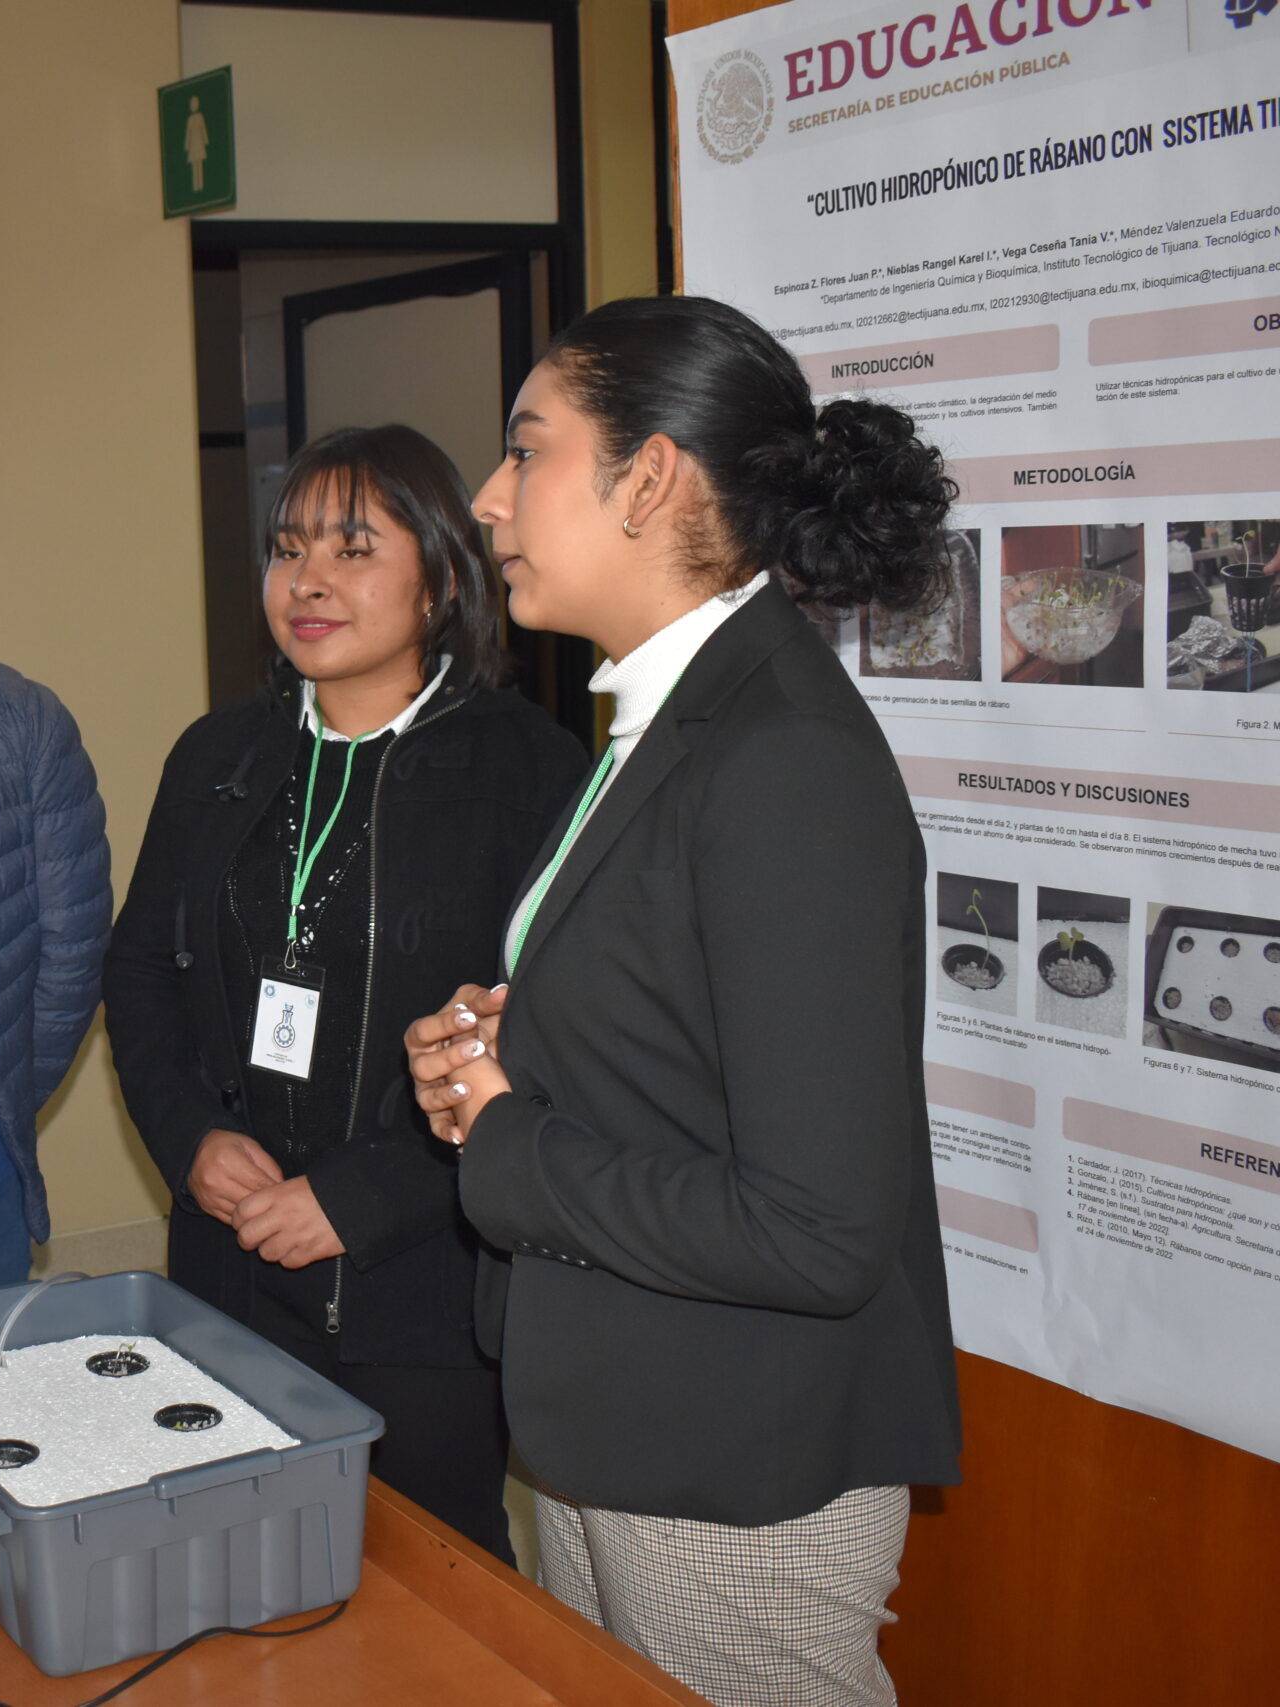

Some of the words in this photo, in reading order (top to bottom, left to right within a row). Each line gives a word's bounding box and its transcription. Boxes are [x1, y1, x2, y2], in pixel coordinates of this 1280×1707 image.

[788, 100, 872, 133] SECRETARÍA
[875, 94, 896, 112] DE
[899, 70, 995, 105] EDUCACIÓN
[999, 52, 1072, 82] PÚBLICA
[881, 157, 999, 202] HIDROPÓNICO
[1004, 150, 1026, 180] DE
[1030, 135, 1106, 174] RÁBANO
[1111, 124, 1153, 158] CON
[1163, 104, 1254, 148] SISTEMA
[1257, 97, 1280, 129] TI
[774, 283, 810, 295] Espinoza
[820, 276, 846, 287] Flores
[848, 272, 869, 283] Juan
[886, 264, 920, 276] Nieblas
[922, 256, 956, 270] Rangel
[958, 252, 984, 265] Karel
[1002, 247, 1027, 259] Vega
[1029, 240, 1067, 254] Ceseña
[1120, 225, 1164, 239] Méndez
[1165, 214, 1227, 232] Valenzuela
[1230, 206, 1280, 222] Eduardo
[880, 286, 891, 296] de
[892, 279, 936, 295] Ingeniería
[937, 274, 976, 287] Química
[986, 264, 1041, 280] Bioquímica,
[1043, 258, 1081, 271] Instituto
[1082, 249, 1143, 265] Tecnológico
[1145, 245, 1159, 256] de
[1161, 240, 1201, 255] Tijuana.
[1204, 229, 1272, 246] Tecnológico
[832, 352, 934, 378] INTRODUCCIÓN
[1014, 462, 1136, 485] METODOLOGÍA
[1236, 719, 1262, 730] Figura
[1263, 720, 1270, 730] 2.
[958, 773, 1056, 796] RESULTADOS
[1060, 782, 1071, 797] Y
[1075, 784, 1190, 808] DISCUSIONES
[1143, 1057, 1172, 1070] Figuras
[1173, 1062, 1179, 1071] 6
[1180, 1066, 1186, 1074] y
[1186, 1065, 1194, 1074] 7.
[1196, 1068, 1229, 1081] Sistema
[1230, 1075, 1275, 1092] hidropónico
[1200, 1143, 1280, 1178] REFEREN
